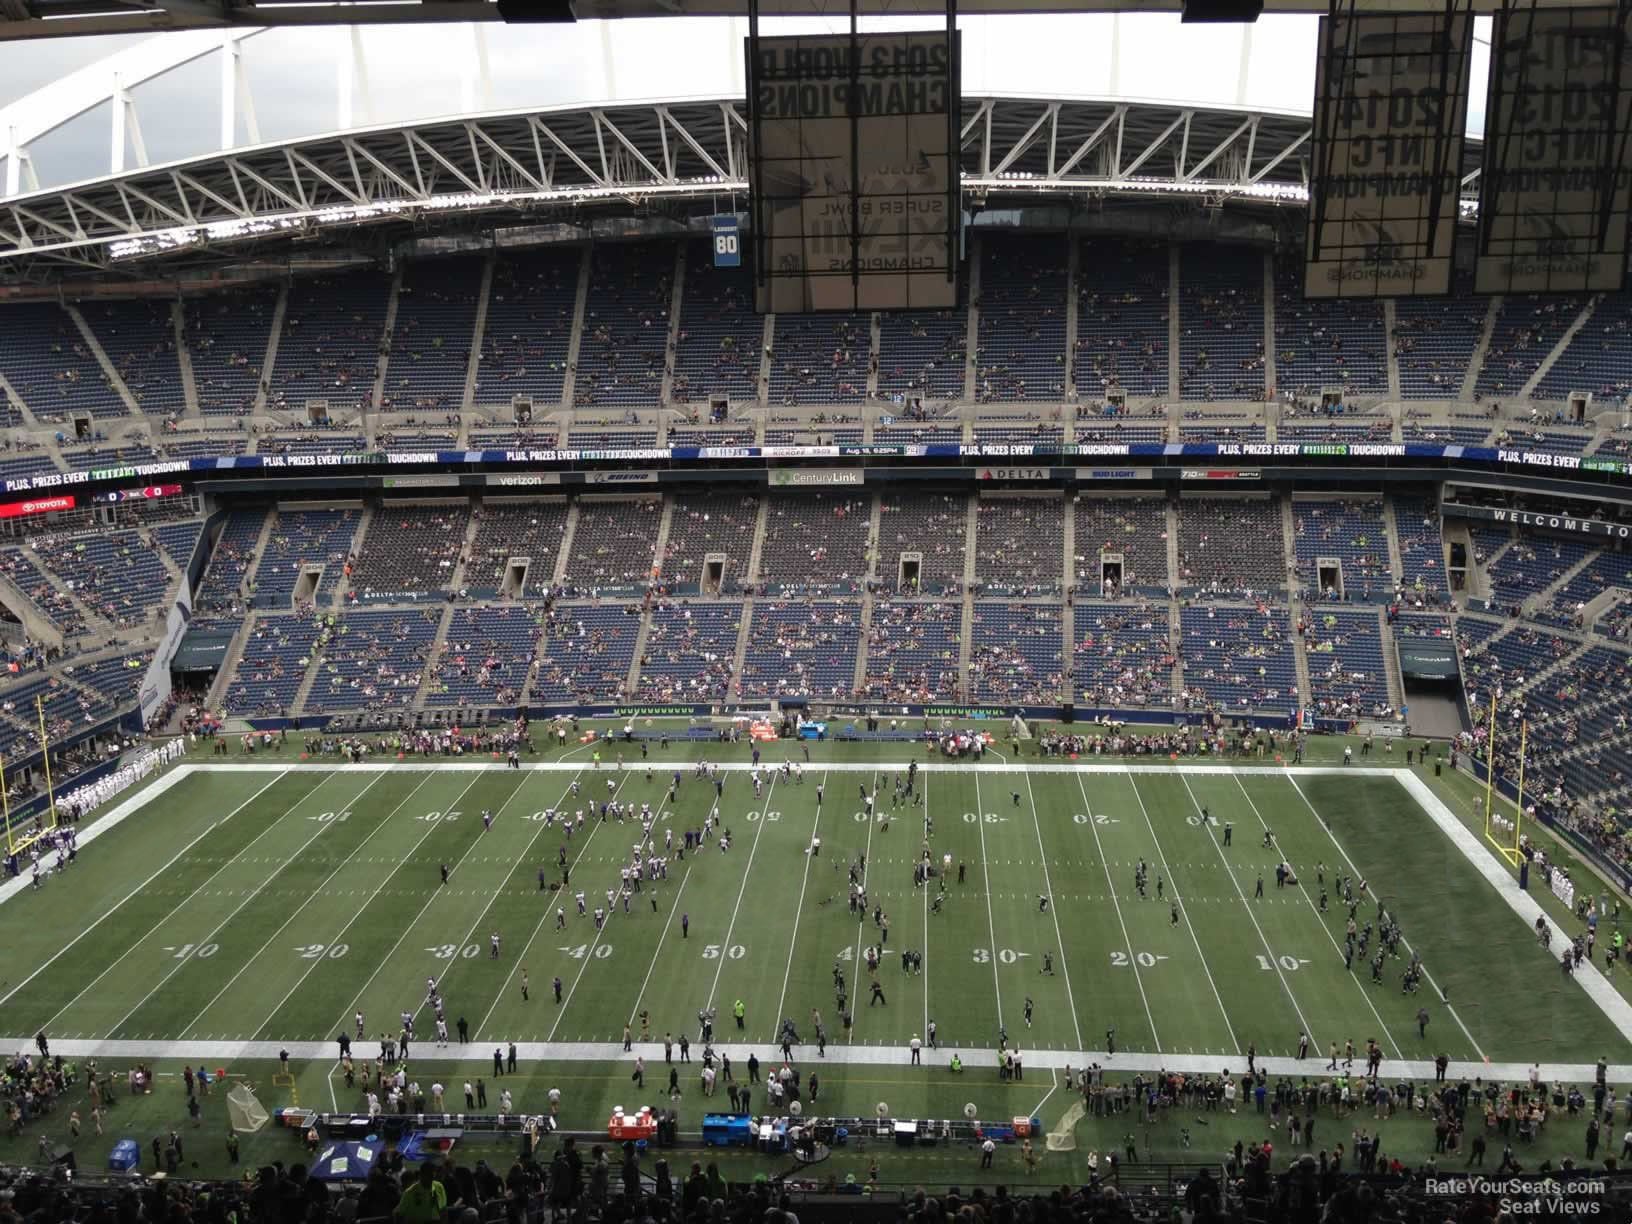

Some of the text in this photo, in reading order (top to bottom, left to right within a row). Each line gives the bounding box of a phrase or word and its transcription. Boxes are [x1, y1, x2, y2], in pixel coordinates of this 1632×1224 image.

[716, 235, 737, 254] 80
[529, 451, 557, 461] PRIZES
[557, 450, 581, 461] EVERY
[982, 445, 1009, 456] PRIZES
[1010, 445, 1034, 456] EVERY
[1242, 444, 1272, 456] PRIZES
[1273, 444, 1300, 456] EVERY
[288, 455, 316, 466] PRIZES
[317, 454, 342, 465] EVERY
[1522, 453, 1552, 466] PRIZES
[1553, 456, 1581, 469] EVERY
[32, 474, 63, 488] PRIZES
[63, 471, 89, 485] EVERY
[500, 475, 542, 486] verizon
[793, 472, 857, 484] CenturyLink
[997, 470, 1043, 479] DELTA
[34, 499, 67, 509] TOYOTA
[1494, 510, 1629, 537] WELCOME TO
[963, 813, 998, 823] 30
[1073, 814, 1110, 825] 20
[173, 943, 220, 958] 10
[301, 944, 349, 958] 20
[435, 944, 480, 958] 30
[568, 944, 613, 958] 40
[702, 945, 746, 959] 50
[973, 948, 1017, 964] 30
[1110, 951, 1156, 967] 20
[1255, 955, 1299, 971] 10
